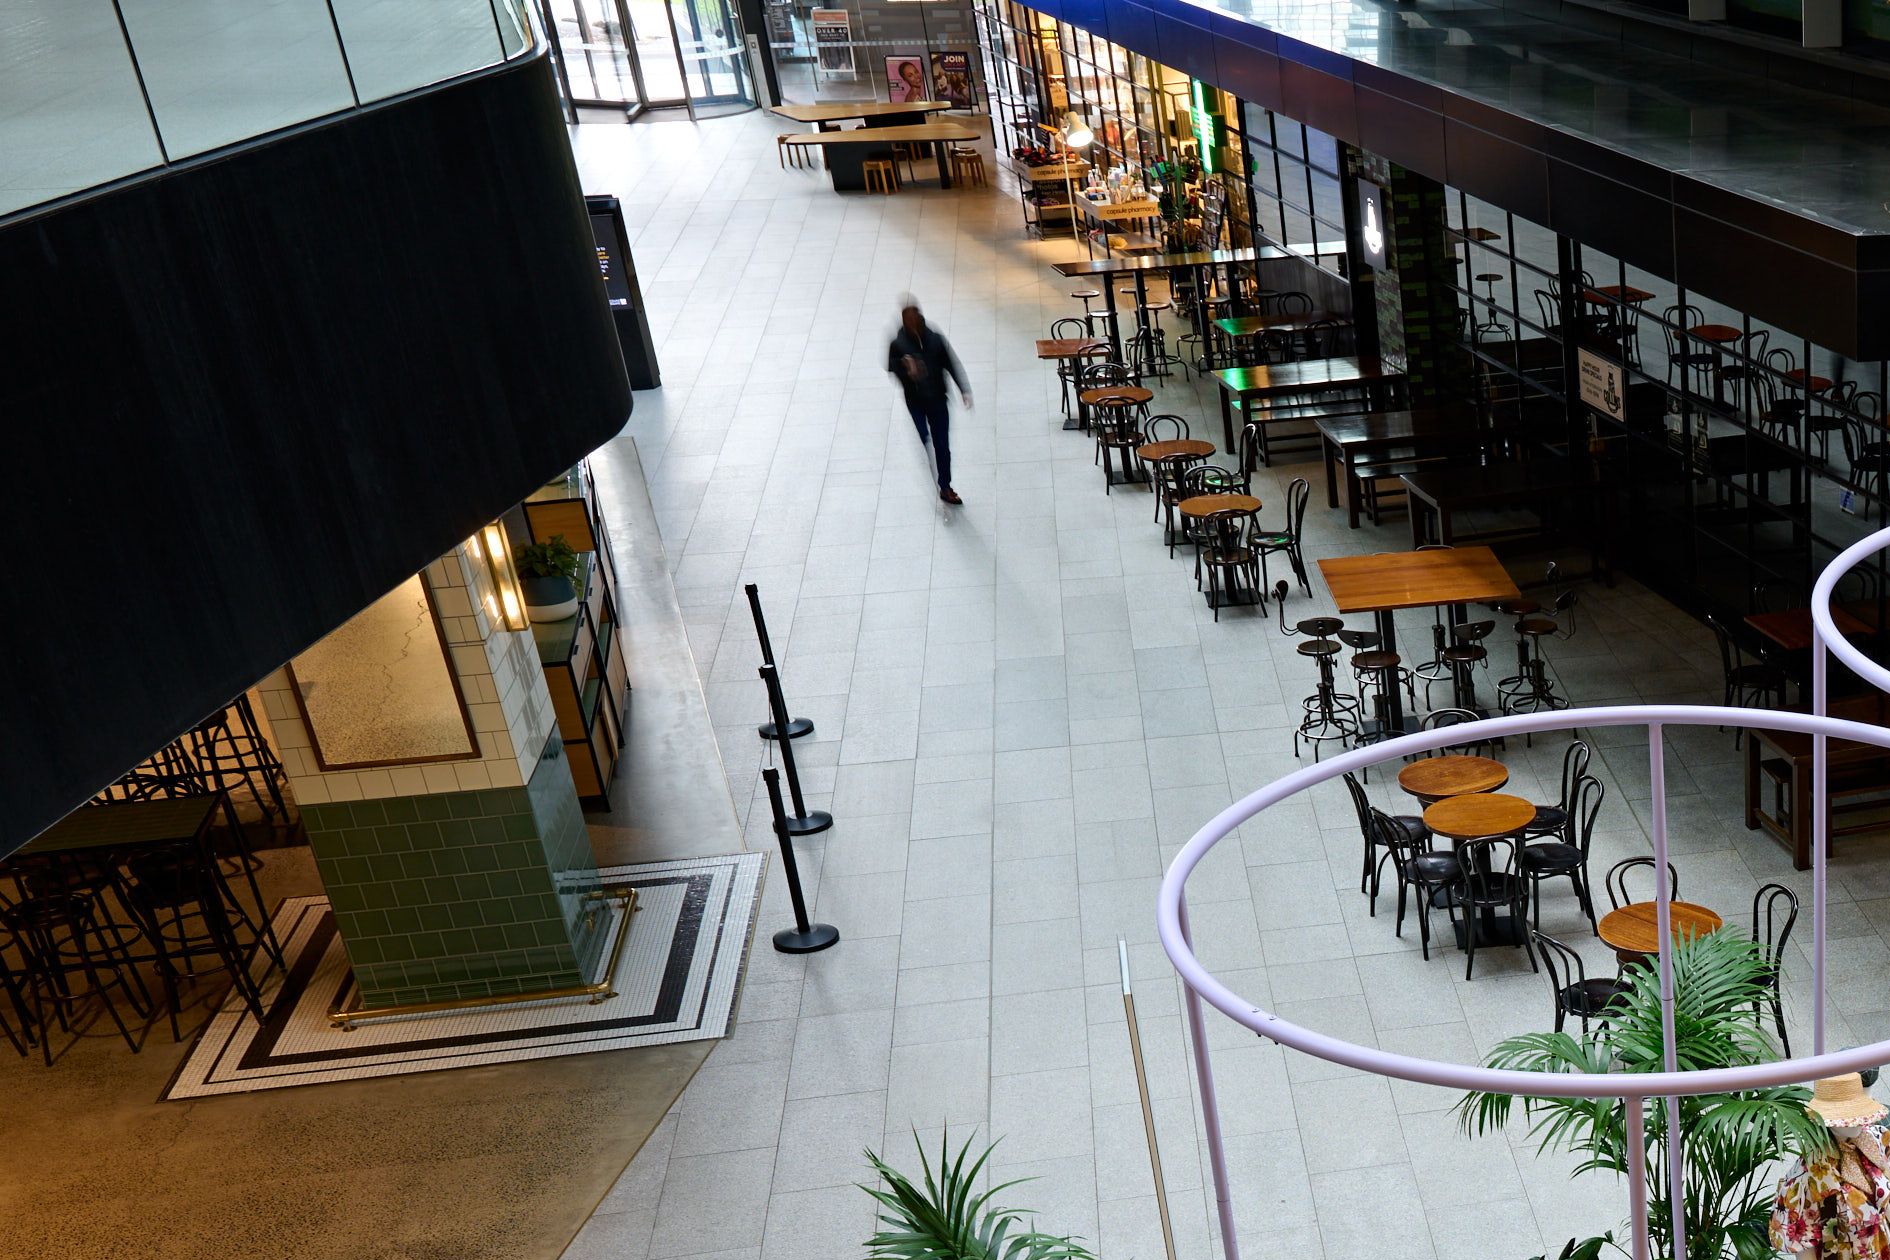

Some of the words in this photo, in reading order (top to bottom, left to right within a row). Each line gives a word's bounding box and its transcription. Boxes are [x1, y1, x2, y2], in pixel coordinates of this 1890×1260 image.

[943, 55, 965, 63] JOIN
[1037, 168, 1057, 176] capsule
[1107, 208, 1127, 216] capsule
[1127, 206, 1155, 215] pharmacy
